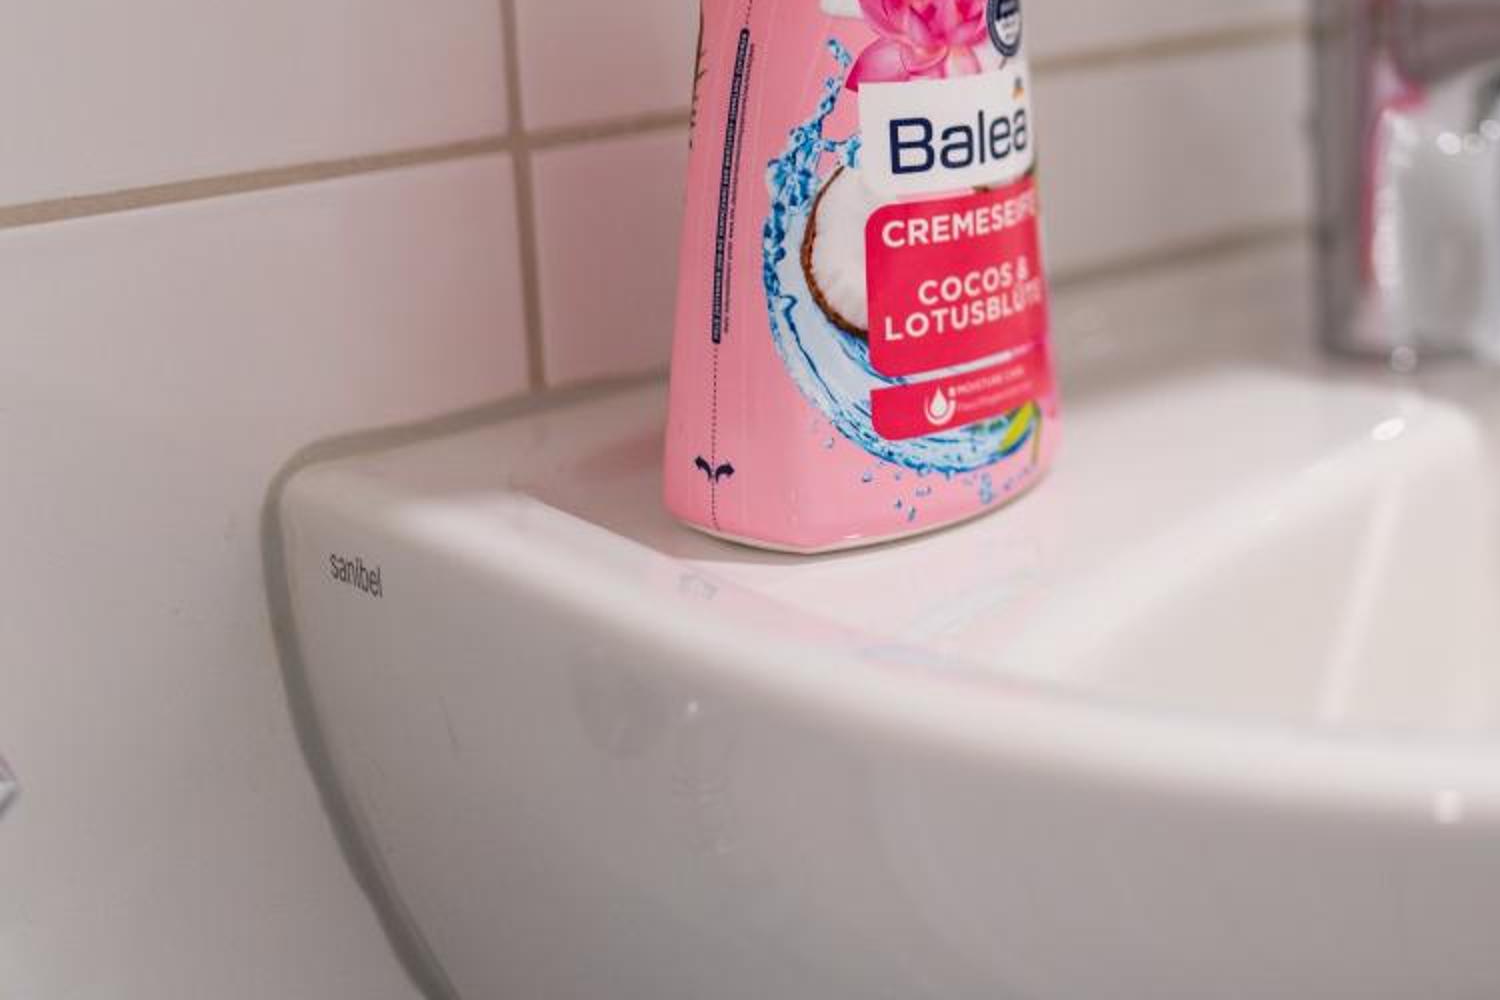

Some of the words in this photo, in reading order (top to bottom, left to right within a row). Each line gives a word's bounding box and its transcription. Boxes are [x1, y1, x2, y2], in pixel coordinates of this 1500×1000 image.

[889, 108, 1027, 175] Balea
[917, 261, 1014, 306] COCOS
[329, 553, 384, 599] sanibel
